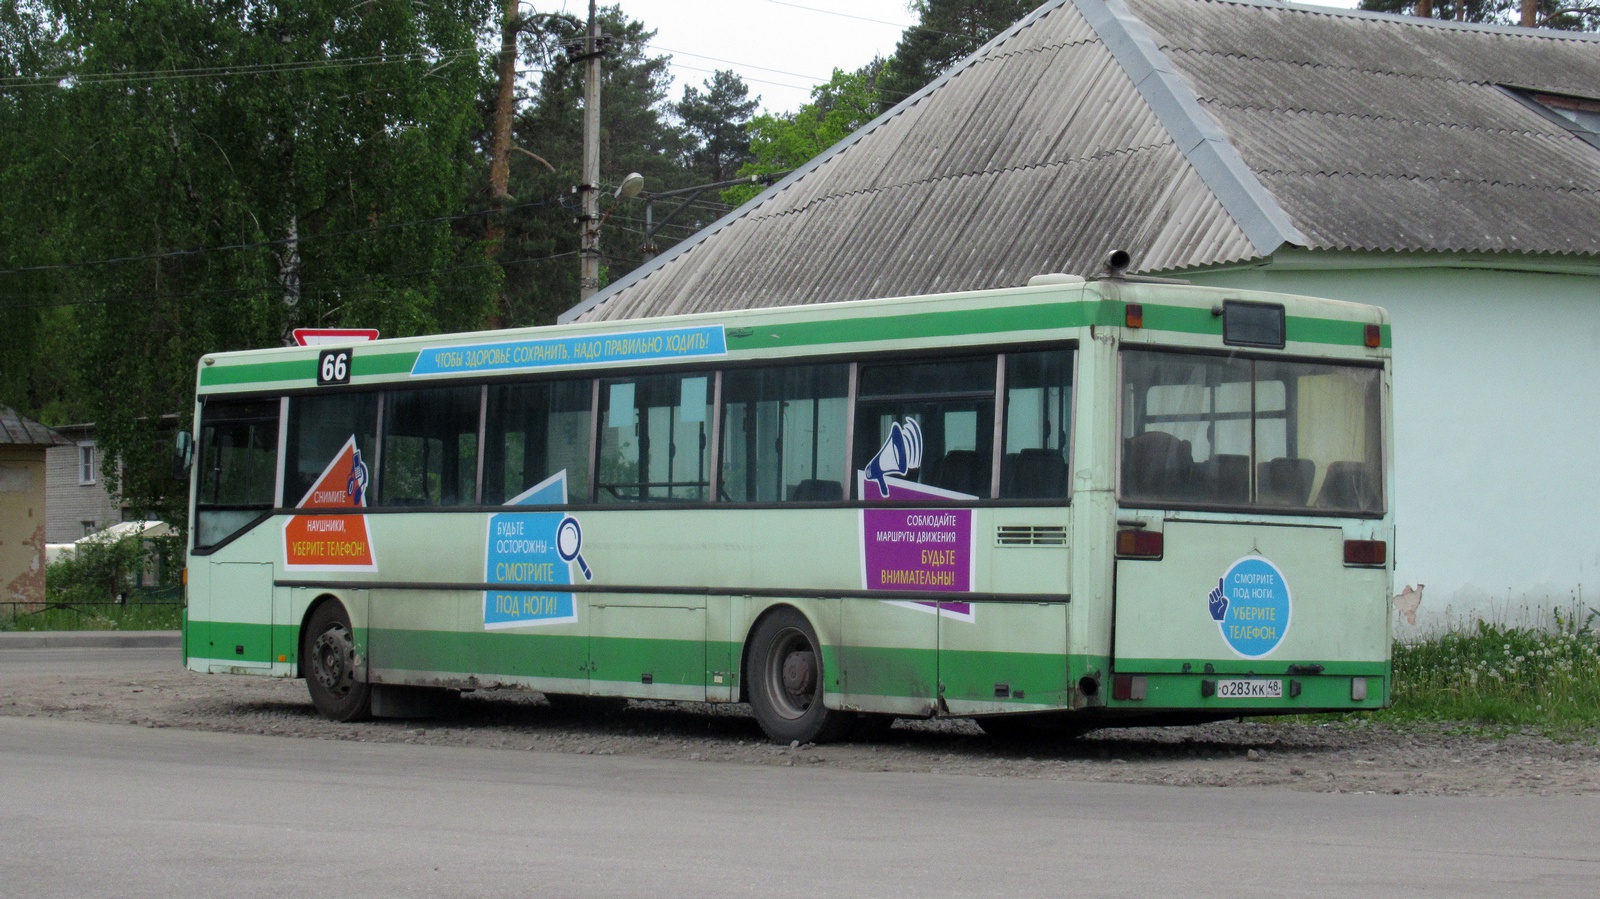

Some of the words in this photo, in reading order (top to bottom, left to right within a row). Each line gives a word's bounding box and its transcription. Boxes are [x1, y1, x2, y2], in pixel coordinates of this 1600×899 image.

[435, 352, 463, 368] ЧТОБЫ
[465, 348, 511, 368] ЗДОРОВЬЕ
[513, 344, 570, 363] СОХРАНИТЬ,
[574, 341, 602, 360] НАДО
[604, 336, 662, 356] ПРАВИЛЬНО
[666, 333, 710, 354] ХОДИТЬ!
[322, 353, 347, 381] 66
[313, 490, 346, 504] СНИМИТЕ
[307, 519, 347, 533] НАУШНИКИ,
[906, 513, 957, 527] СОБЛЮДАЙТЕ
[497, 521, 525, 537] БУДЬТЕ
[876, 531, 915, 543] МАРШРУТЫ
[916, 531, 956, 544] ДВИЖЕНИЯ
[292, 541, 324, 557] УБЕРИТЕ
[326, 541, 366, 557] ТЕЛЕФОН!
[496, 540, 547, 554] ОСТОРОЖНЫ
[921, 549, 956, 567] БУДЬТЕ
[496, 562, 554, 582] СМОТРИТЕ
[881, 569, 956, 586] ВНИМАТЕЛЬНЫ!
[1234, 573, 1275, 585] СМОТРИТЕ
[1233, 588, 1250, 600] ПОД
[1251, 588, 1275, 600] НОГИ.
[495, 594, 520, 617] ПОД
[523, 595, 558, 615] НОГИ!
[1232, 606, 1276, 621] УБЕРИТЕ
[1229, 625, 1279, 640] ТЕЛЕФОН.
